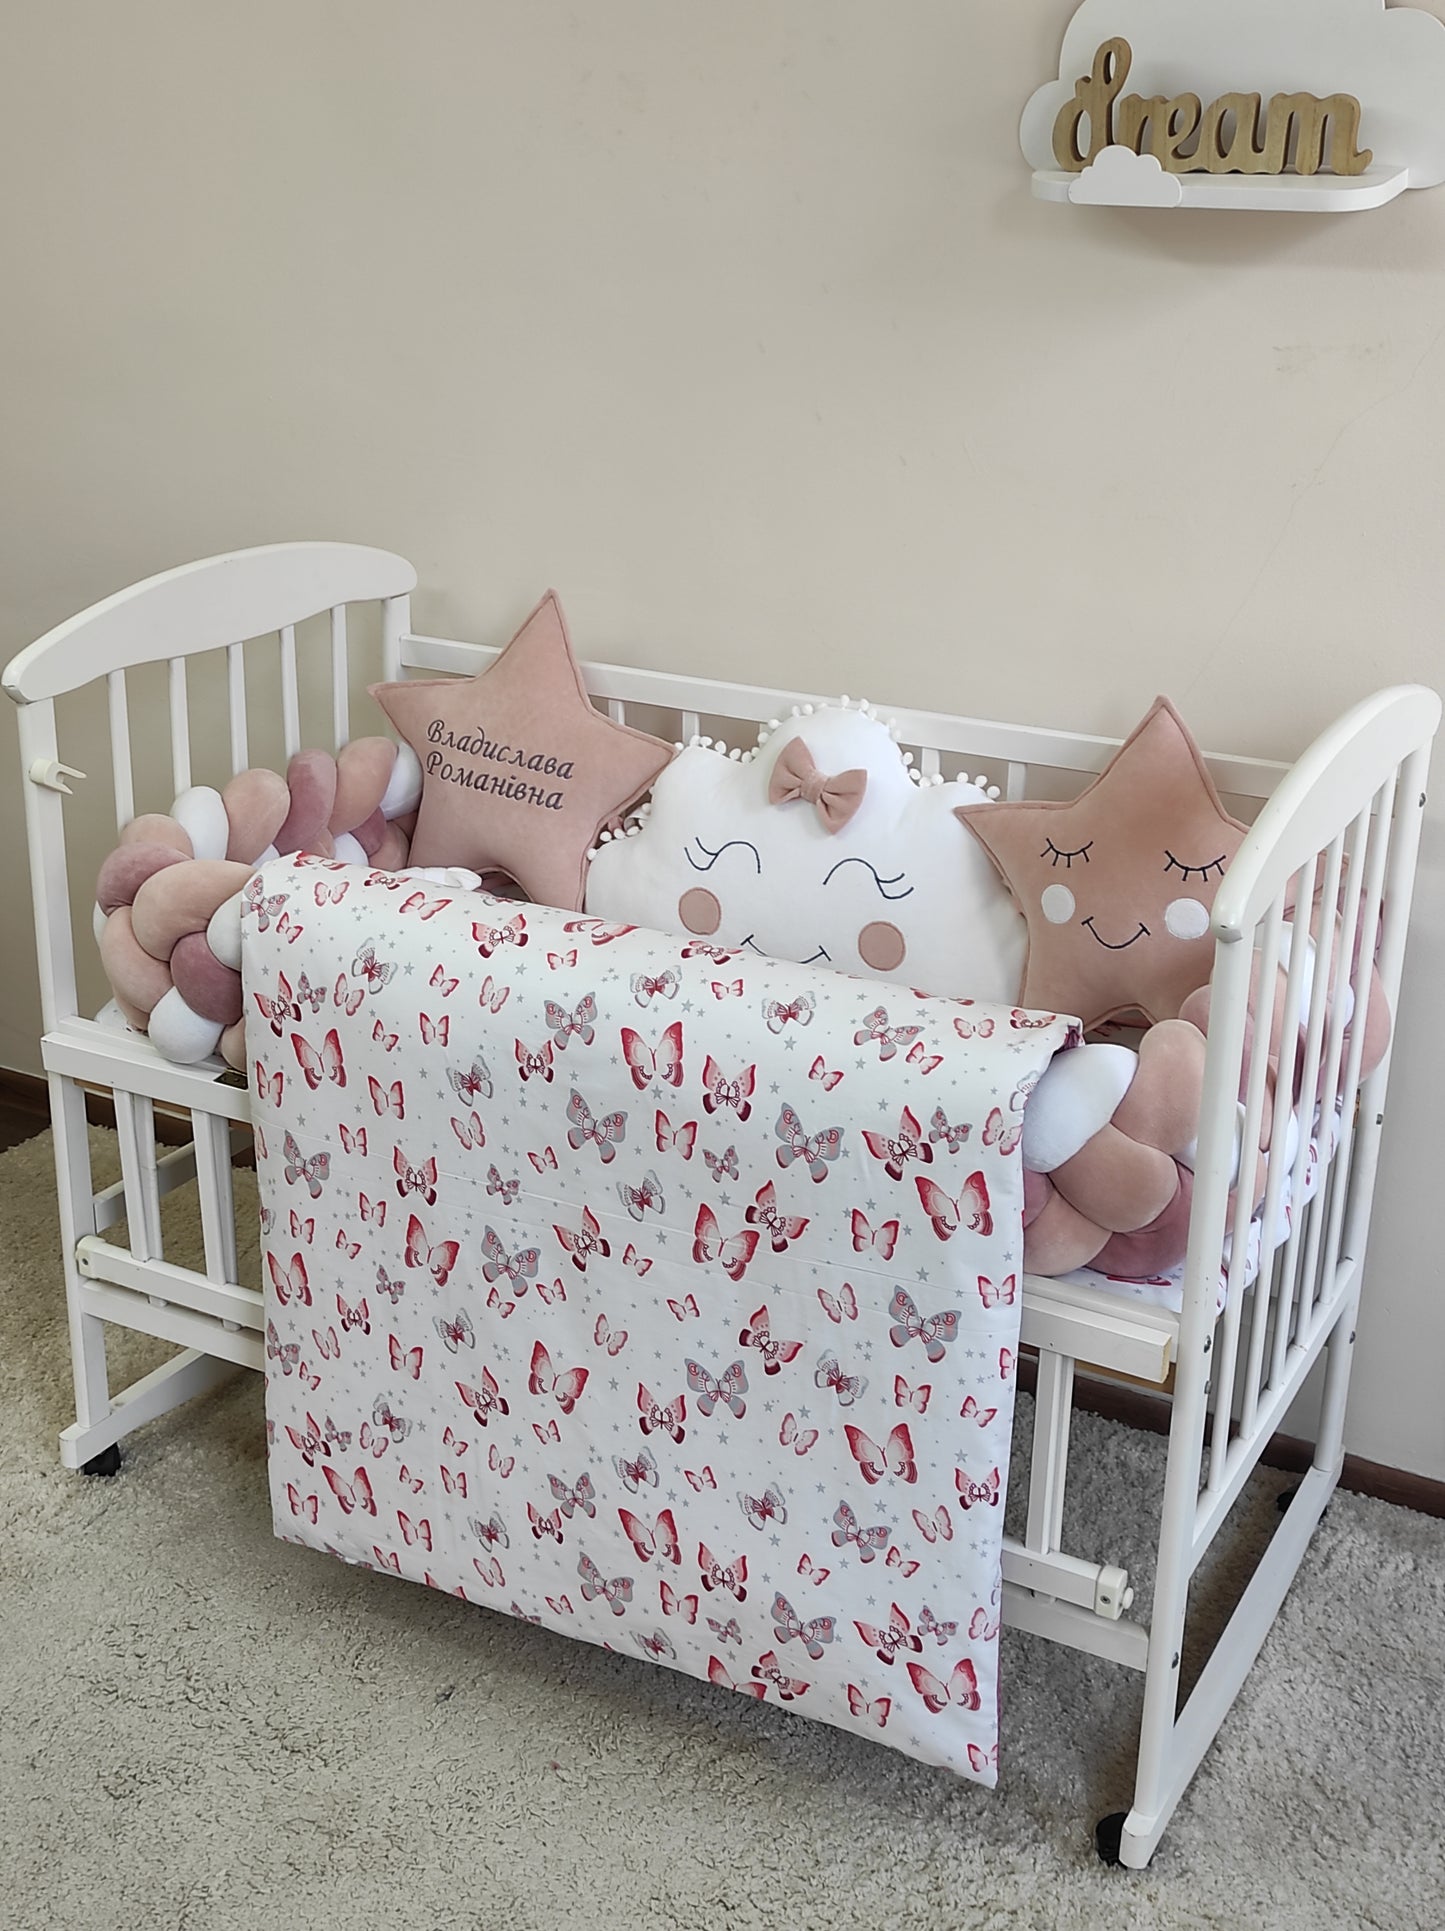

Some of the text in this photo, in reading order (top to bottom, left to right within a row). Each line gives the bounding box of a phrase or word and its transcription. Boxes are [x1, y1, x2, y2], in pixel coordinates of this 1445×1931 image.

[1052, 36, 1374, 176] dream
[427, 719, 575, 780] Владислава
[426, 751, 564, 810] Романівна
